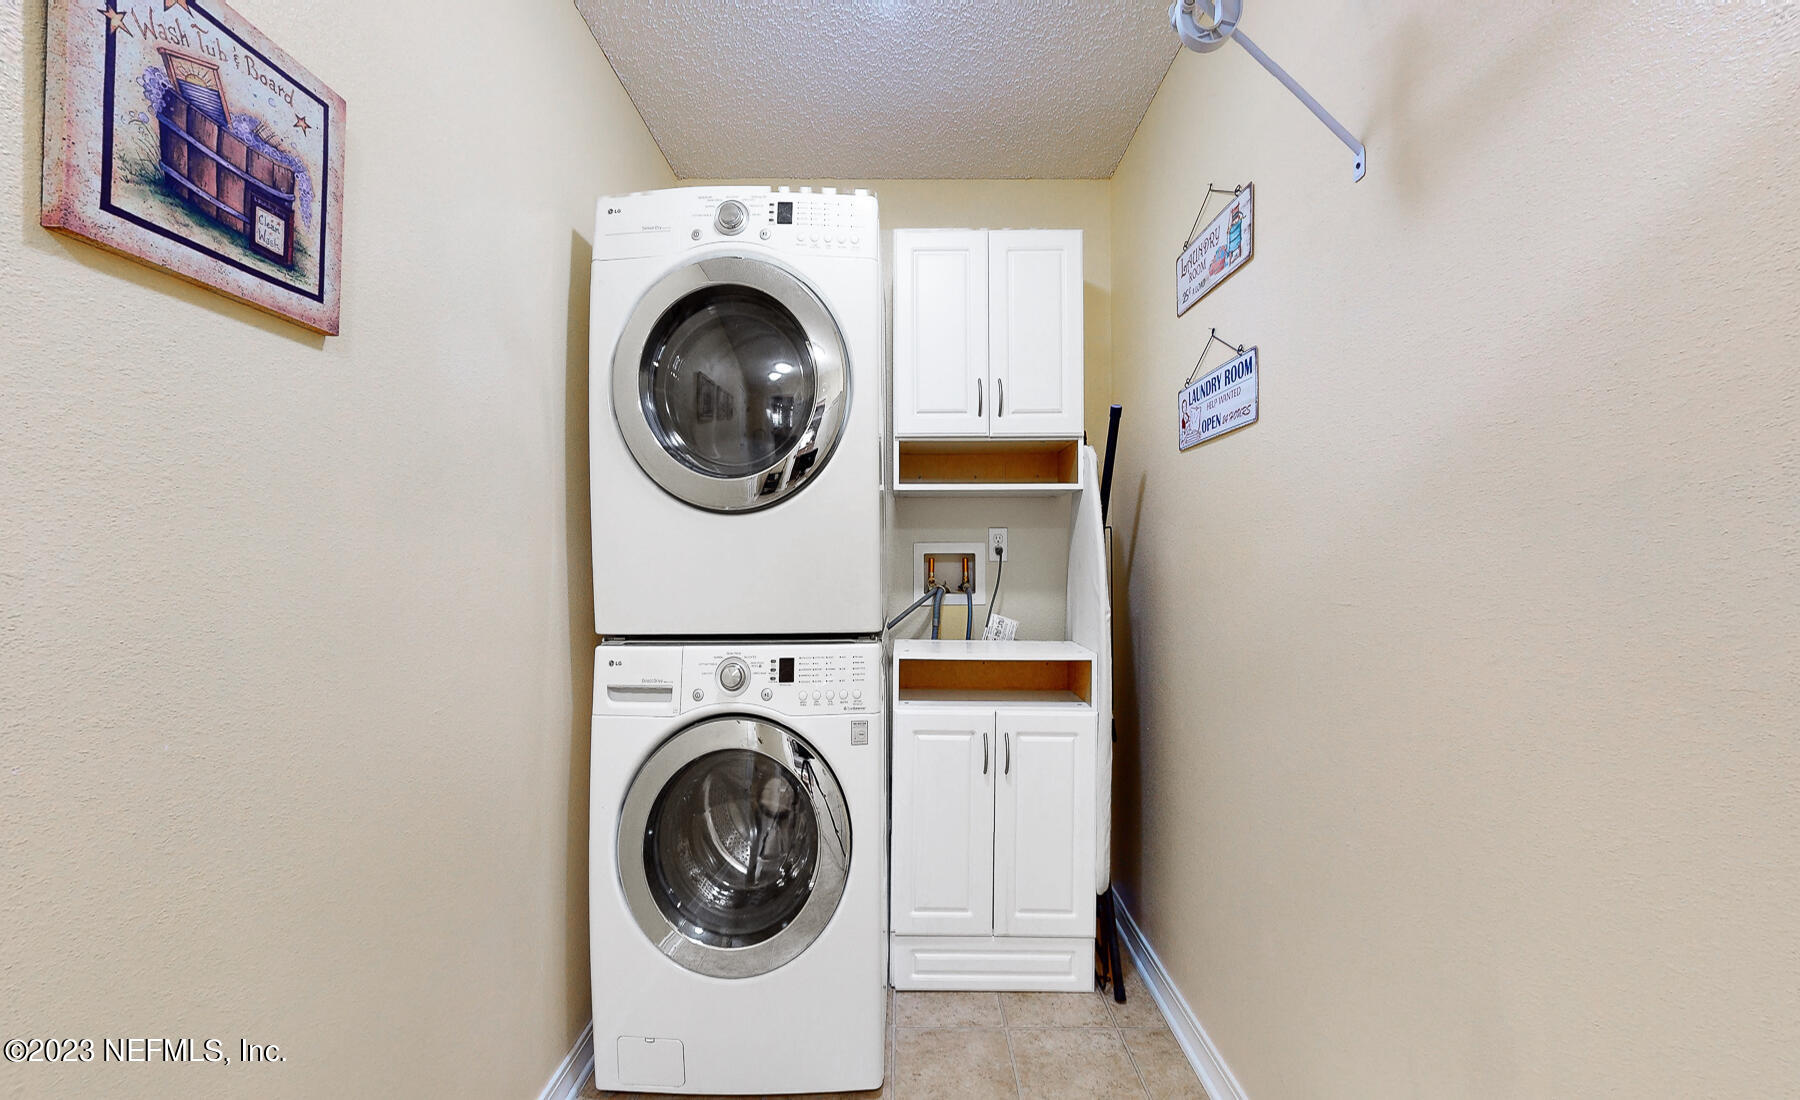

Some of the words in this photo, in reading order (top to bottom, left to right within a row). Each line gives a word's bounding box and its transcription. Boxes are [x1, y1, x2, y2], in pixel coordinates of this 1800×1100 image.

[131, 6, 190, 48] Wash
[190, 23, 229, 62] Tub
[244, 54, 295, 108] Board
[258, 214, 281, 235] Clean
[258, 229, 281, 251] Wash
[1180, 225, 1221, 279] LAUNDRY
[1188, 259, 1208, 283] ROOM
[1188, 373, 1222, 406] LAUNDRY
[1224, 356, 1253, 387] ROOM
[1206, 398, 1218, 411] HELP
[1218, 386, 1242, 405] WANTED
[1201, 413, 1221, 434] OPEN
